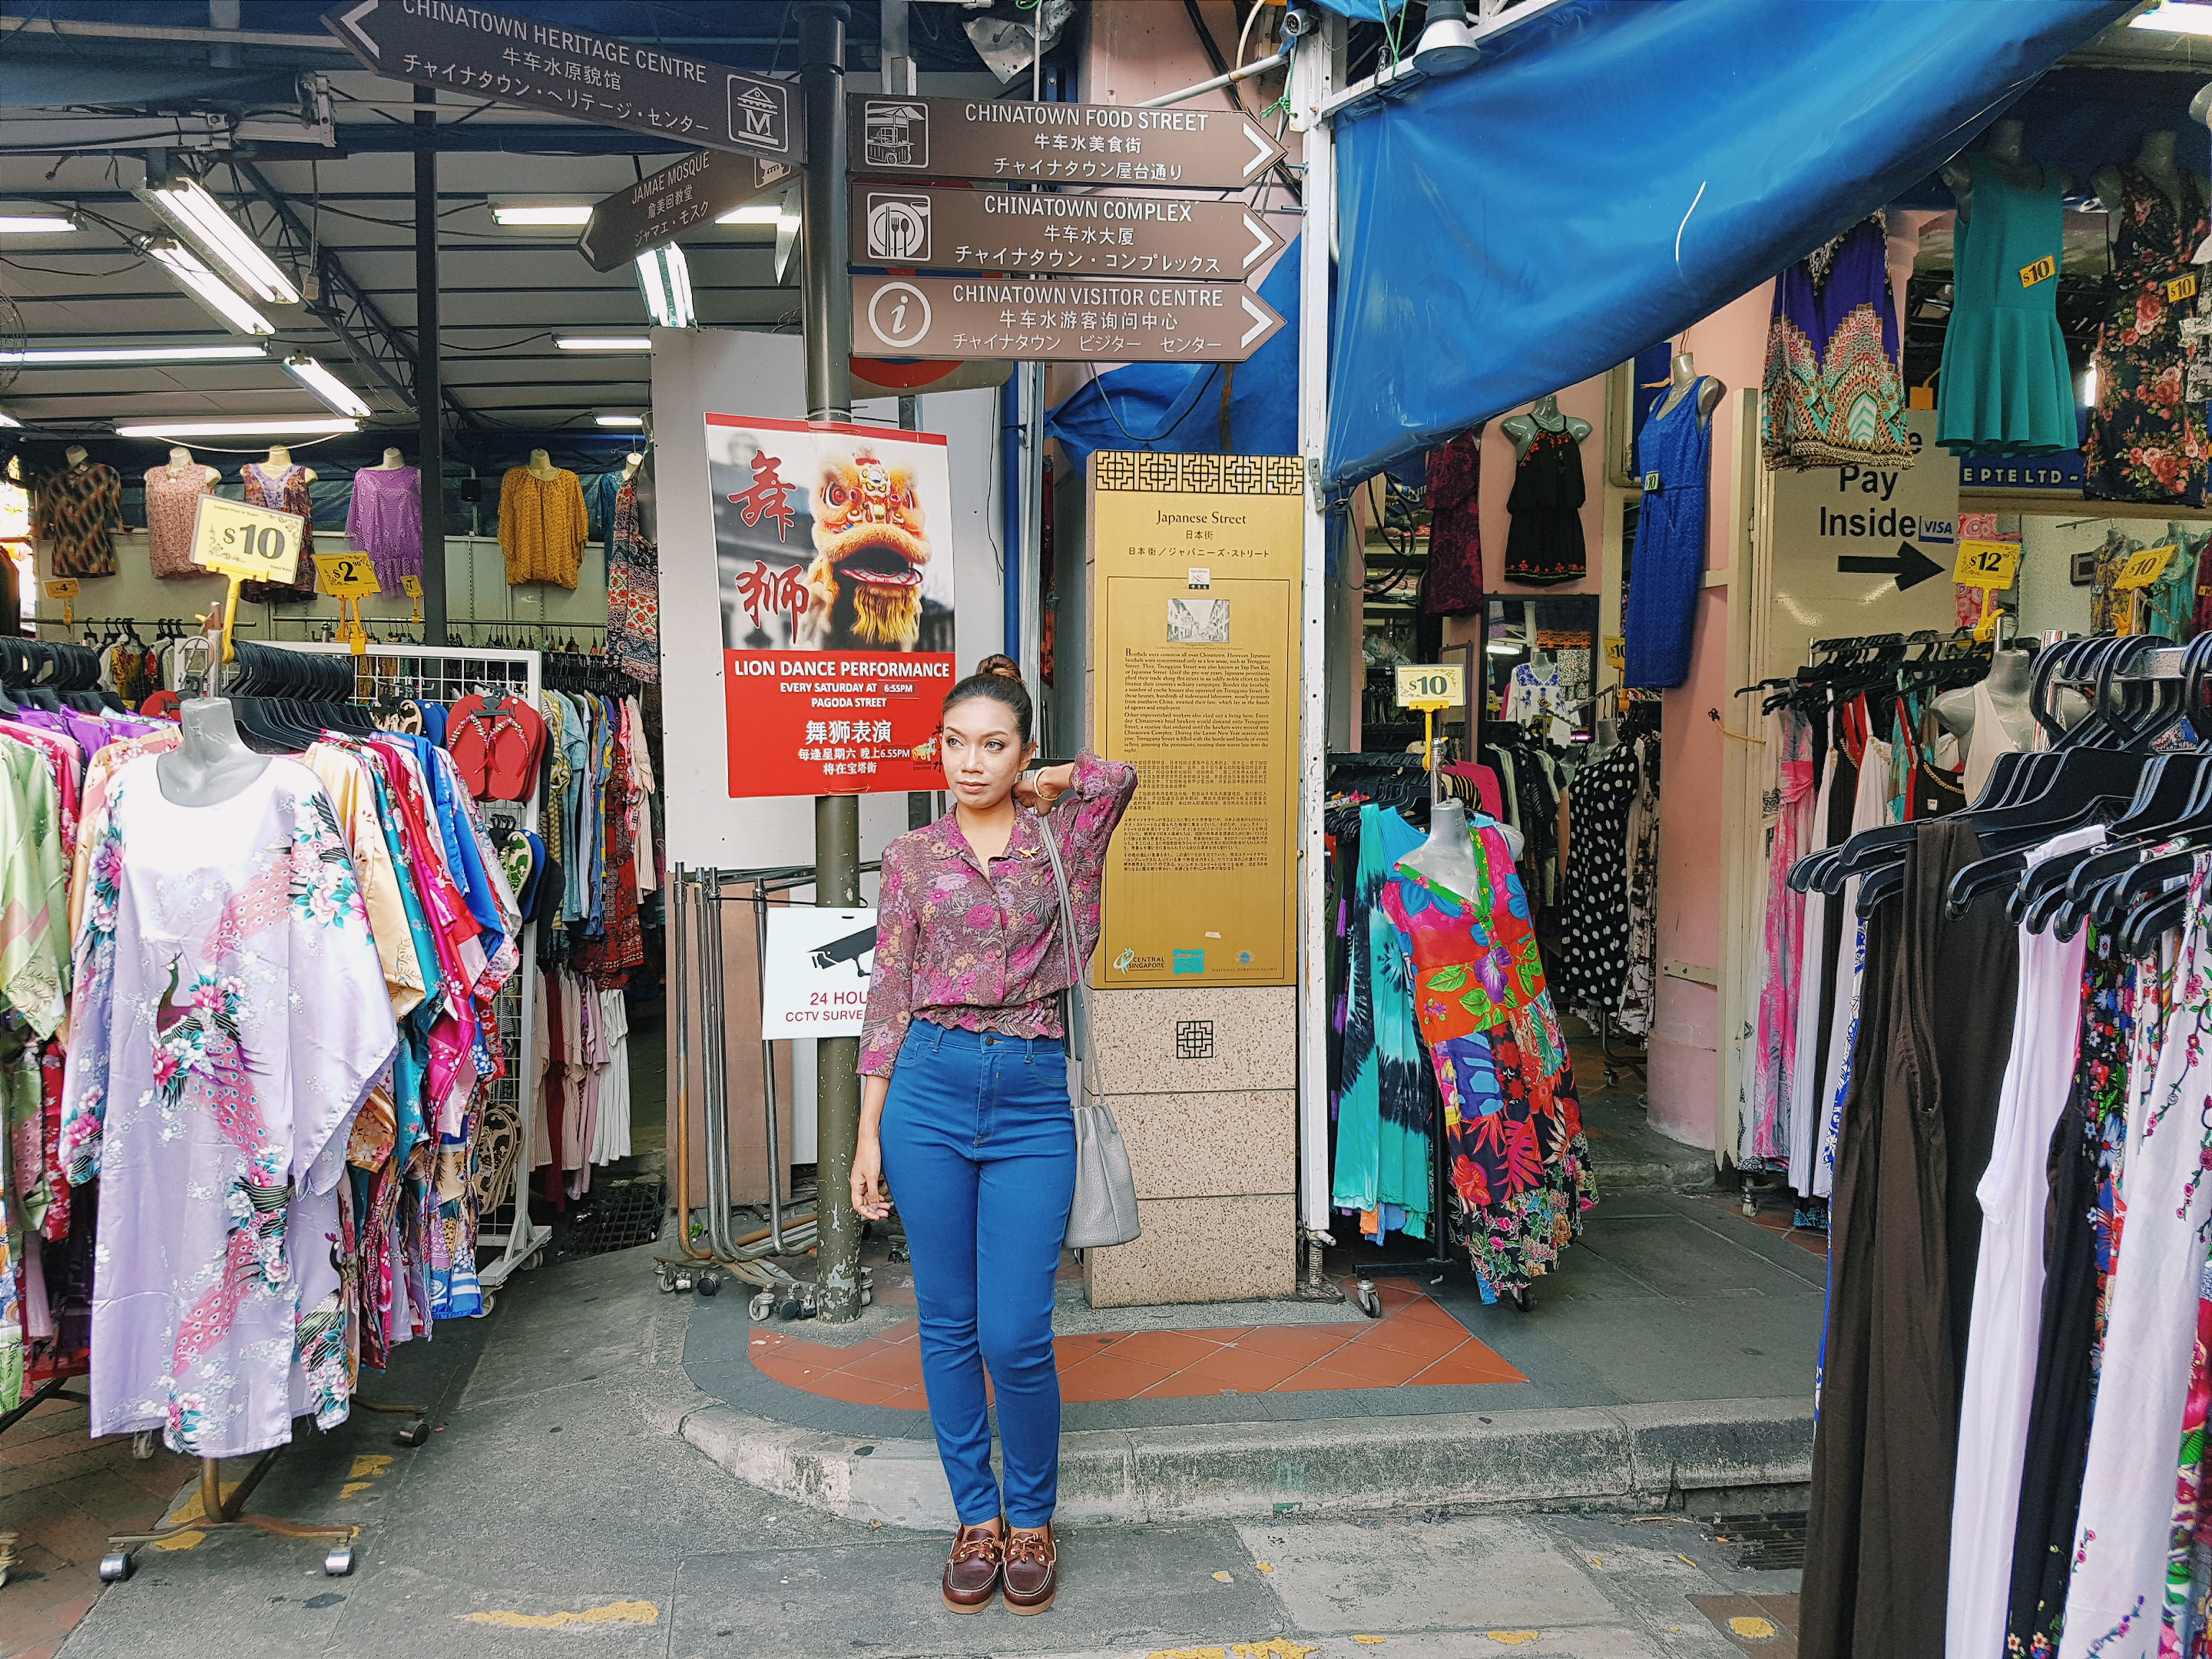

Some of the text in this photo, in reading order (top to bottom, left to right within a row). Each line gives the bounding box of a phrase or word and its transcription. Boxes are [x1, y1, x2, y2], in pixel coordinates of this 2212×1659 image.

[403, 0, 706, 83] CHINATOWN HERITAGE CENTRE
[502, 48, 621, 91] 牛车水原貌馆
[965, 104, 1208, 131] CHINATOWN FOOD STREET
[1034, 134, 1141, 154] 牛车水美食街
[632, 152, 710, 204] JAMAE MOSQUE
[985, 196, 1191, 222] CHINATOWN COMPLEX
[1045, 226, 1134, 245] 牛车水大厦
[2023, 259, 2051, 285] $10
[953, 285, 1223, 306] CHINATOWN VISITOR CENTRE
[2171, 279, 2191, 297] $10
[999, 310, 1178, 331] 牛车水游客询问中心
[952, 334, 1061, 351] チャイナタウン
[1839, 465, 1898, 501] Pay
[1981, 469, 2017, 483] PTE
[2025, 470, 2062, 485] LTD
[1156, 510, 1246, 525] Japanese Street
[1820, 507, 1916, 537] Inside
[1186, 530, 1214, 540] 日本街
[1925, 521, 1952, 535] VISA
[224, 524, 284, 559] $10
[735, 661, 949, 677] LION DANCE PERFORMANCE
[780, 682, 912, 693] EVERY SATURDAY AT 6:55PM
[1409, 676, 1447, 694] $10
[812, 697, 886, 707] PAGODA STREET
[806, 720, 891, 744] 舞狮表演
[810, 992, 828, 1005] 24
[786, 1010, 863, 1022] CCTV SURVE
